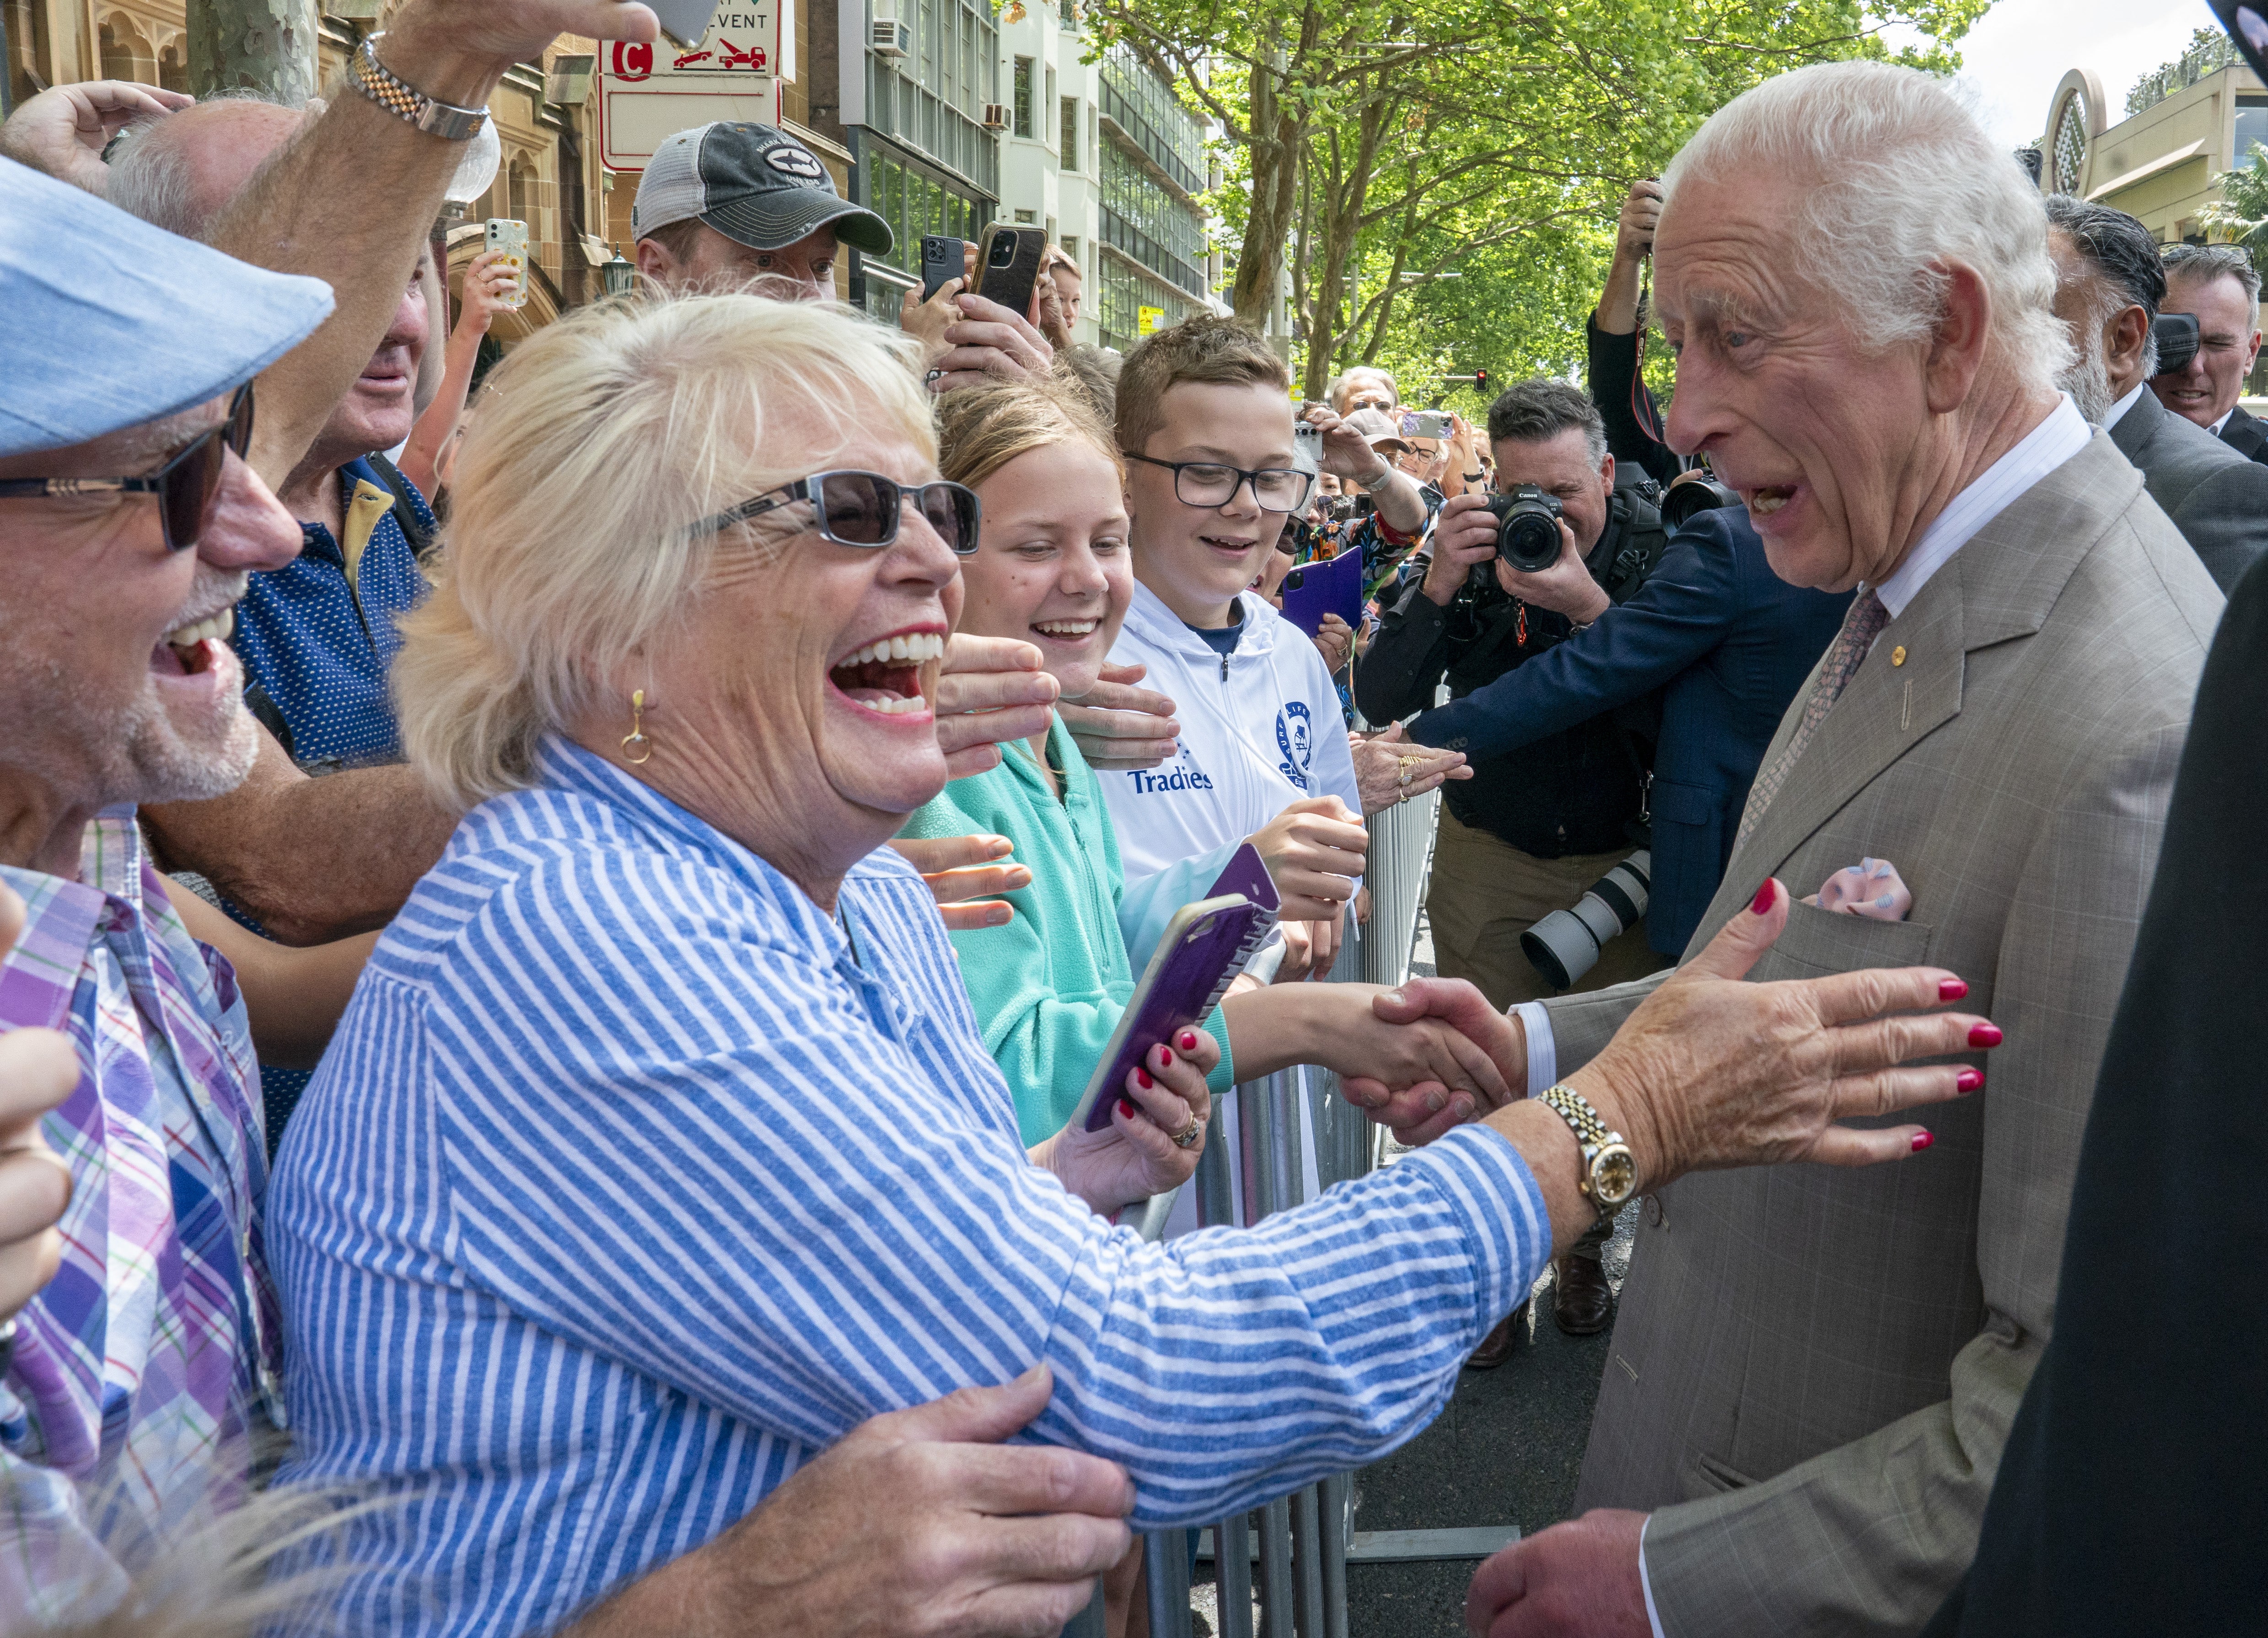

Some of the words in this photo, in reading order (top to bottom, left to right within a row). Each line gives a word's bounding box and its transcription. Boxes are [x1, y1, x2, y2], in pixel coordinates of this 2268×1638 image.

[756, 139, 781, 153] SHARK
[1287, 706, 1306, 715] LIFE
[1279, 722, 1291, 754] SURF
[1127, 766, 1214, 794] Tradies
